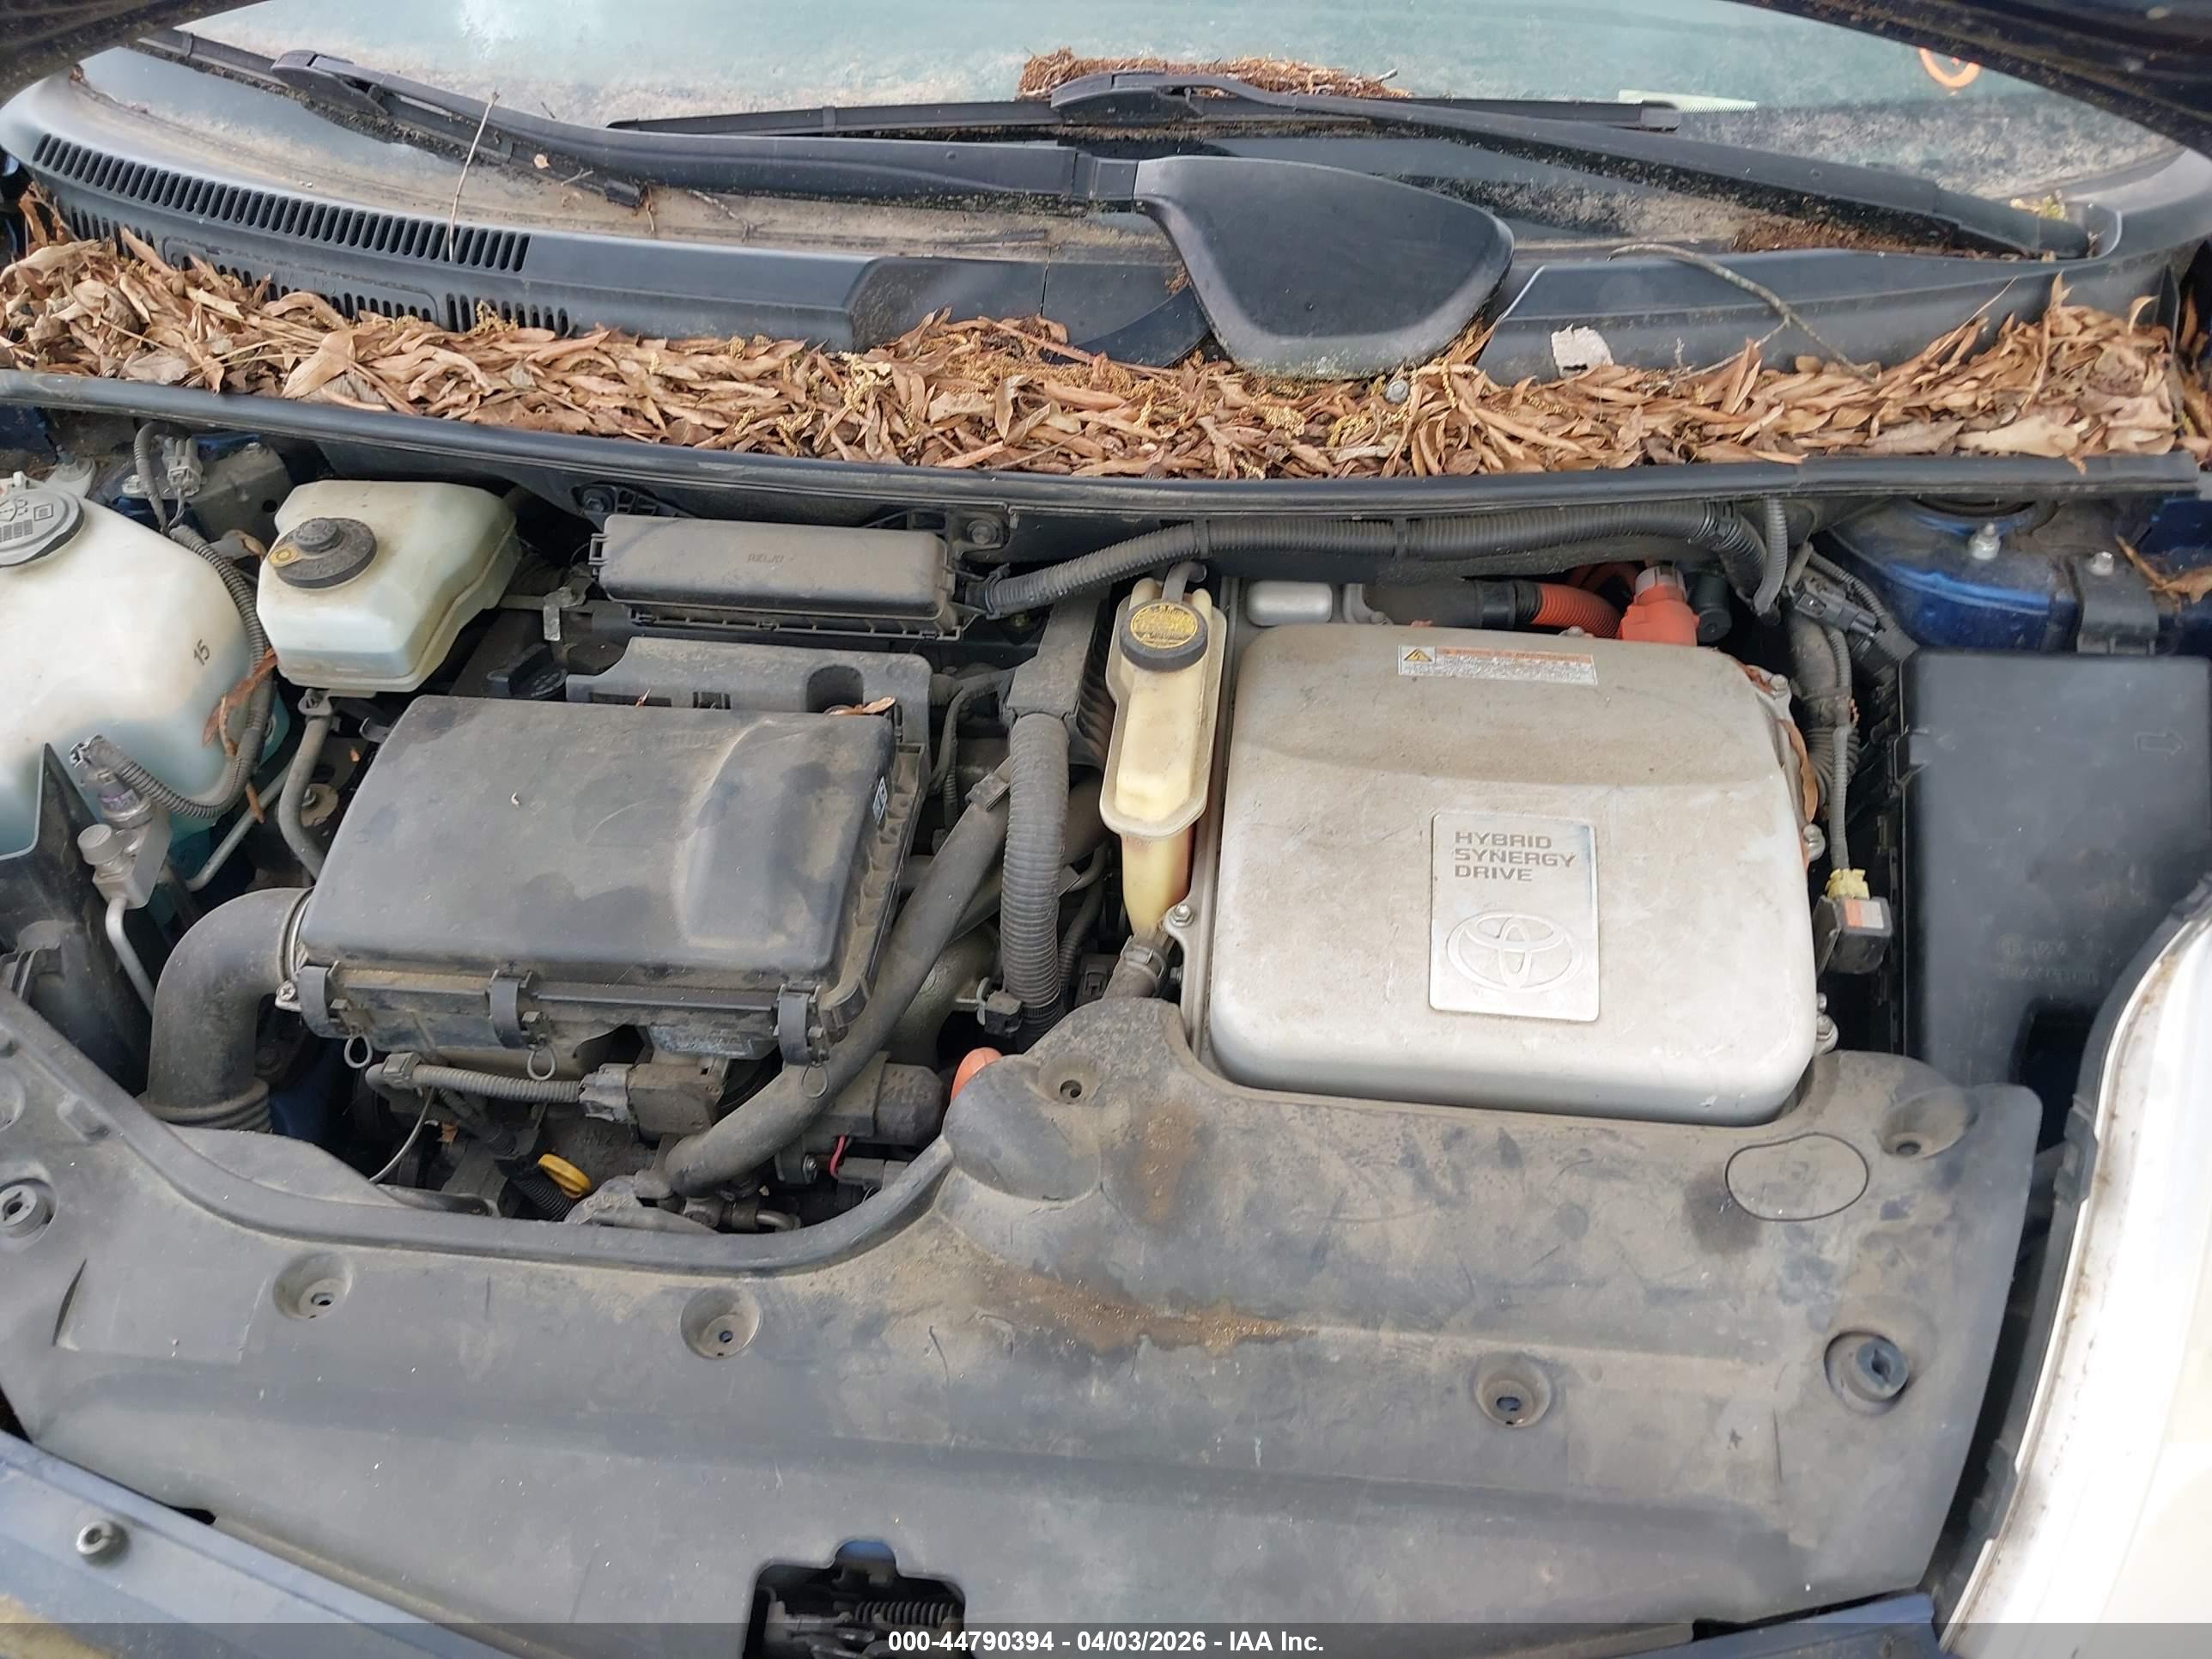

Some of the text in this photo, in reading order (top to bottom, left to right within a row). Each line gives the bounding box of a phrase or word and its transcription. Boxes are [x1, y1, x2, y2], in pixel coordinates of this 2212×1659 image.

[193, 638, 210, 666] 15
[1455, 831, 1553, 849] HYBRID
[1454, 848, 1577, 868] SYNERGY
[1454, 865, 1533, 882] DRIVE
